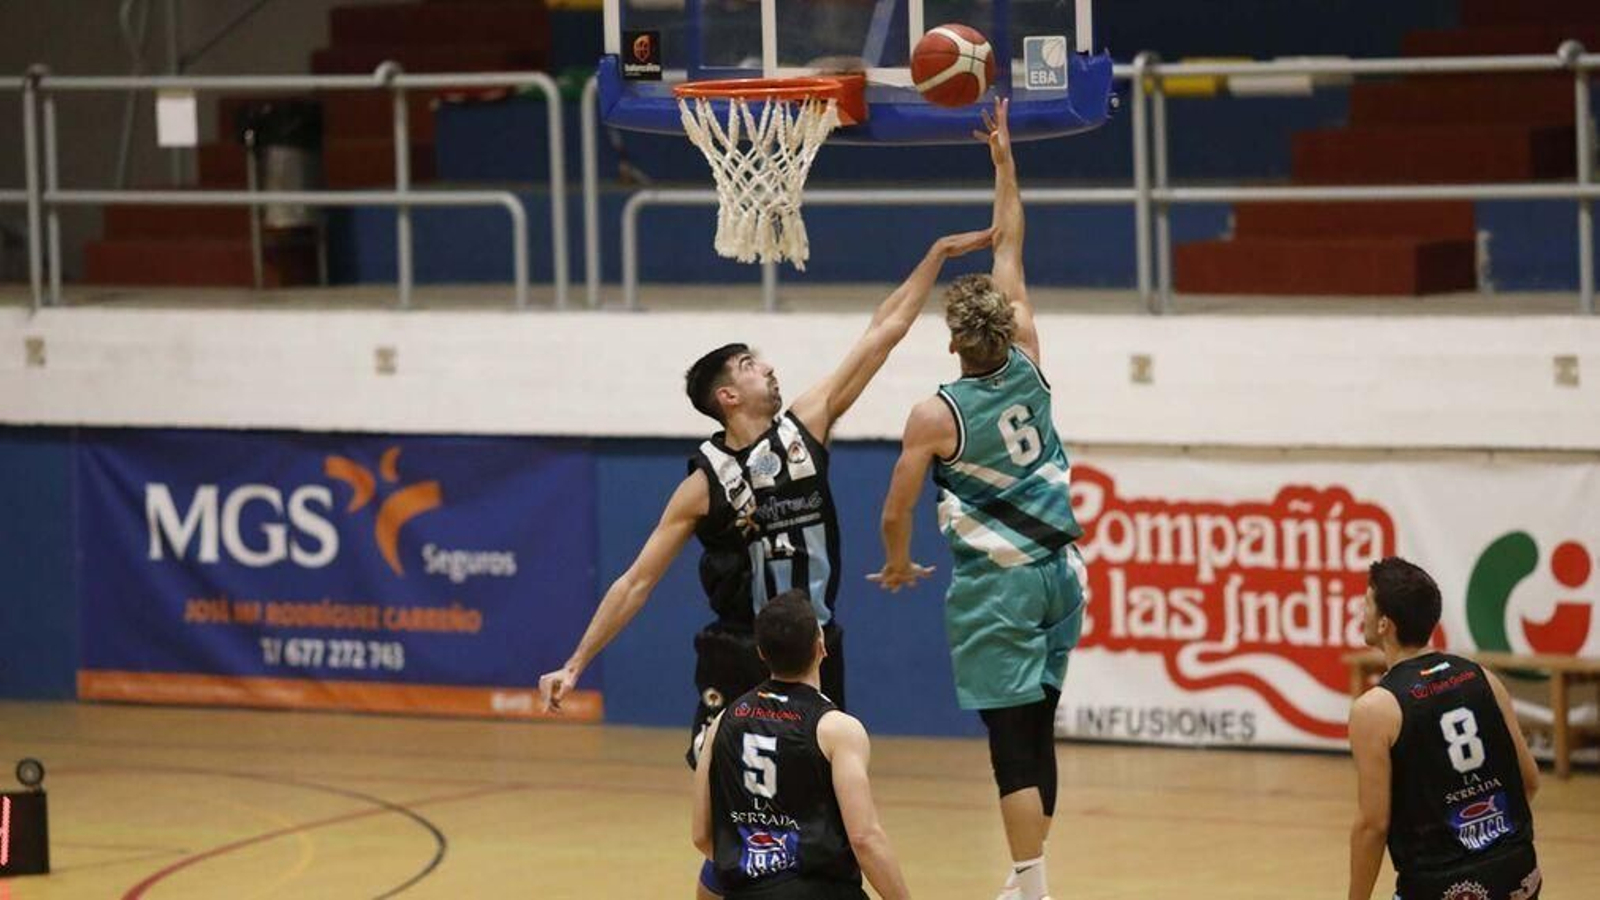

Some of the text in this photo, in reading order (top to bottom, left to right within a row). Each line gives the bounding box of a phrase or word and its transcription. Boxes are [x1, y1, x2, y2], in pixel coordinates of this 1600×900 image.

[1030, 70, 1058, 85] EBA
[998, 404, 1041, 467] 6
[145, 483, 339, 568] MGS
[422, 543, 517, 582] Seguros
[265, 597, 380, 630] RODRÍGUEZ
[383, 602, 483, 634] CARREÑO
[1108, 568, 1208, 640] las
[1216, 573, 1367, 652] India
[285, 638, 323, 669] 677
[327, 639, 366, 670] 272
[1077, 706, 1257, 739] INFUSIONES
[1440, 707, 1485, 773] 8
[743, 732, 778, 799] 5
